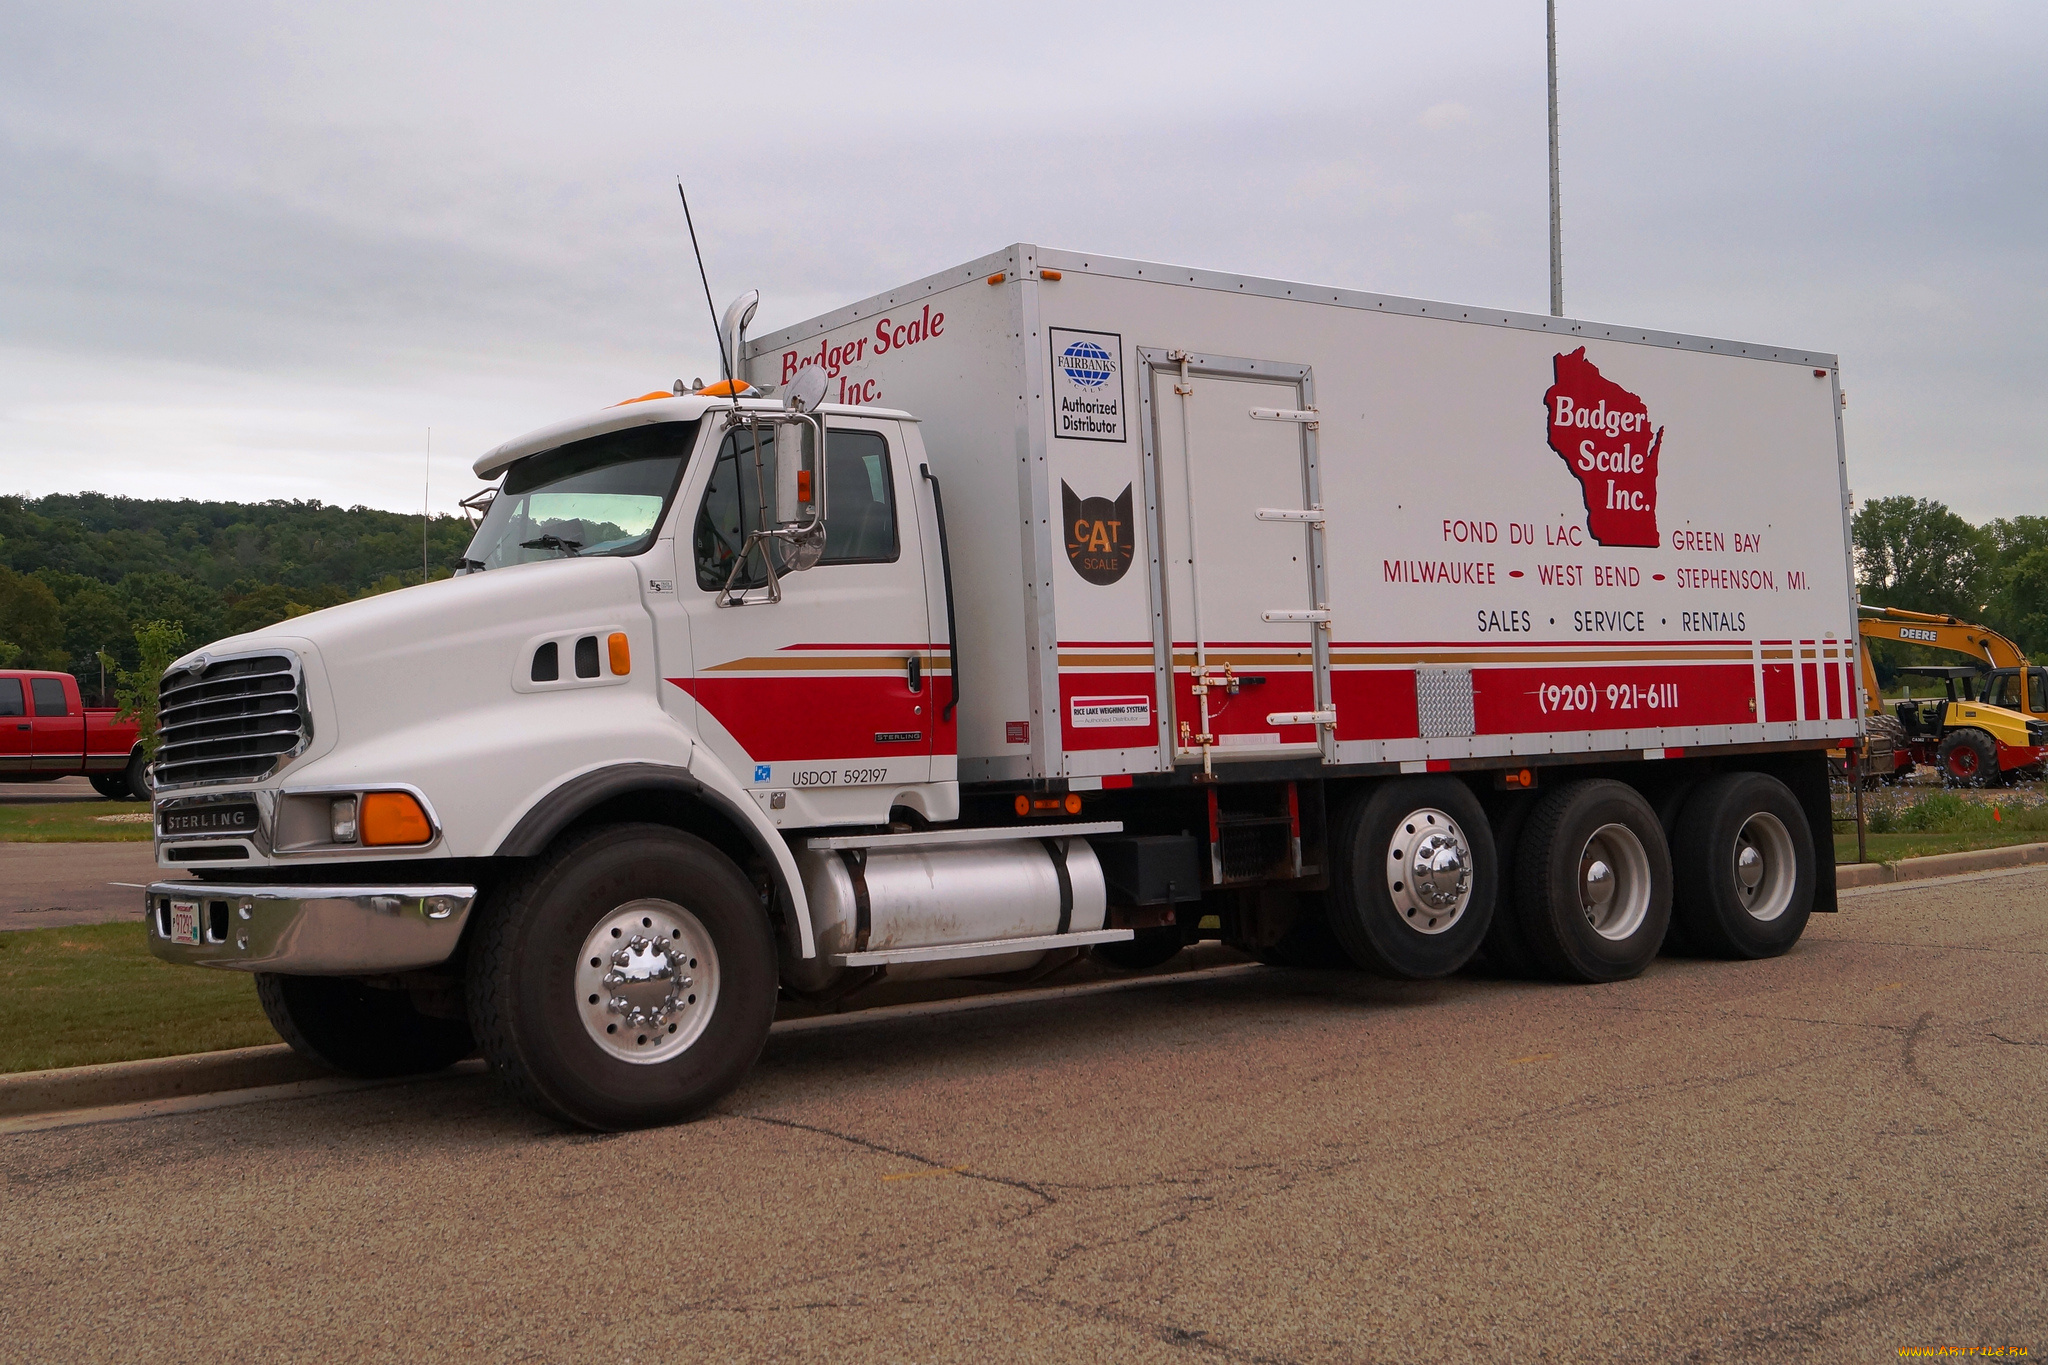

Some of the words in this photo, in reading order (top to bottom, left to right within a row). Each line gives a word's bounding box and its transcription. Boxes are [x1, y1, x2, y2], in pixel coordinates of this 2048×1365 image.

[873, 304, 945, 355] Scale
[1057, 355, 1117, 372] FAIRBANKS
[839, 376, 882, 405] Inc.
[1061, 396, 1117, 415] Authorized
[1554, 395, 1646, 438] Badger
[1063, 415, 1117, 433] Distributor
[1577, 440, 1645, 474] Scale
[1605, 479, 1650, 511] Inc.
[1074, 519, 1122, 553] CAT
[1442, 519, 1498, 544] FOND
[1509, 522, 1535, 545] DU
[1545, 524, 1583, 547] LAC
[1672, 530, 1725, 552] GREEN
[1734, 533, 1761, 553] BAY
[1084, 558, 1118, 570] SCALE
[1383, 560, 1496, 584] MILWAUKEE
[1537, 564, 1583, 586] WEST
[1594, 565, 1640, 587] BEND
[1676, 568, 1779, 593] STEPHENSON,
[1787, 571, 1811, 591] MI.
[1477, 610, 1531, 632] SALES
[1573, 610, 1645, 632] SERVICE
[1681, 611, 1746, 632] RENTALS
[1900, 628, 1937, 641] DEERE
[1538, 681, 1598, 715] (920)
[1606, 683, 1679, 710] 921-6111
[1073, 708, 1085, 716] RICE
[1085, 707, 1099, 715] LAKE
[1099, 706, 1126, 715] WEIGHING
[1126, 705, 1148, 713] SYSTEMS
[877, 733, 921, 741] STERLING
[792, 771, 838, 786] USDOT
[843, 768, 888, 784] 592197
[168, 811, 245, 829] STERLING
